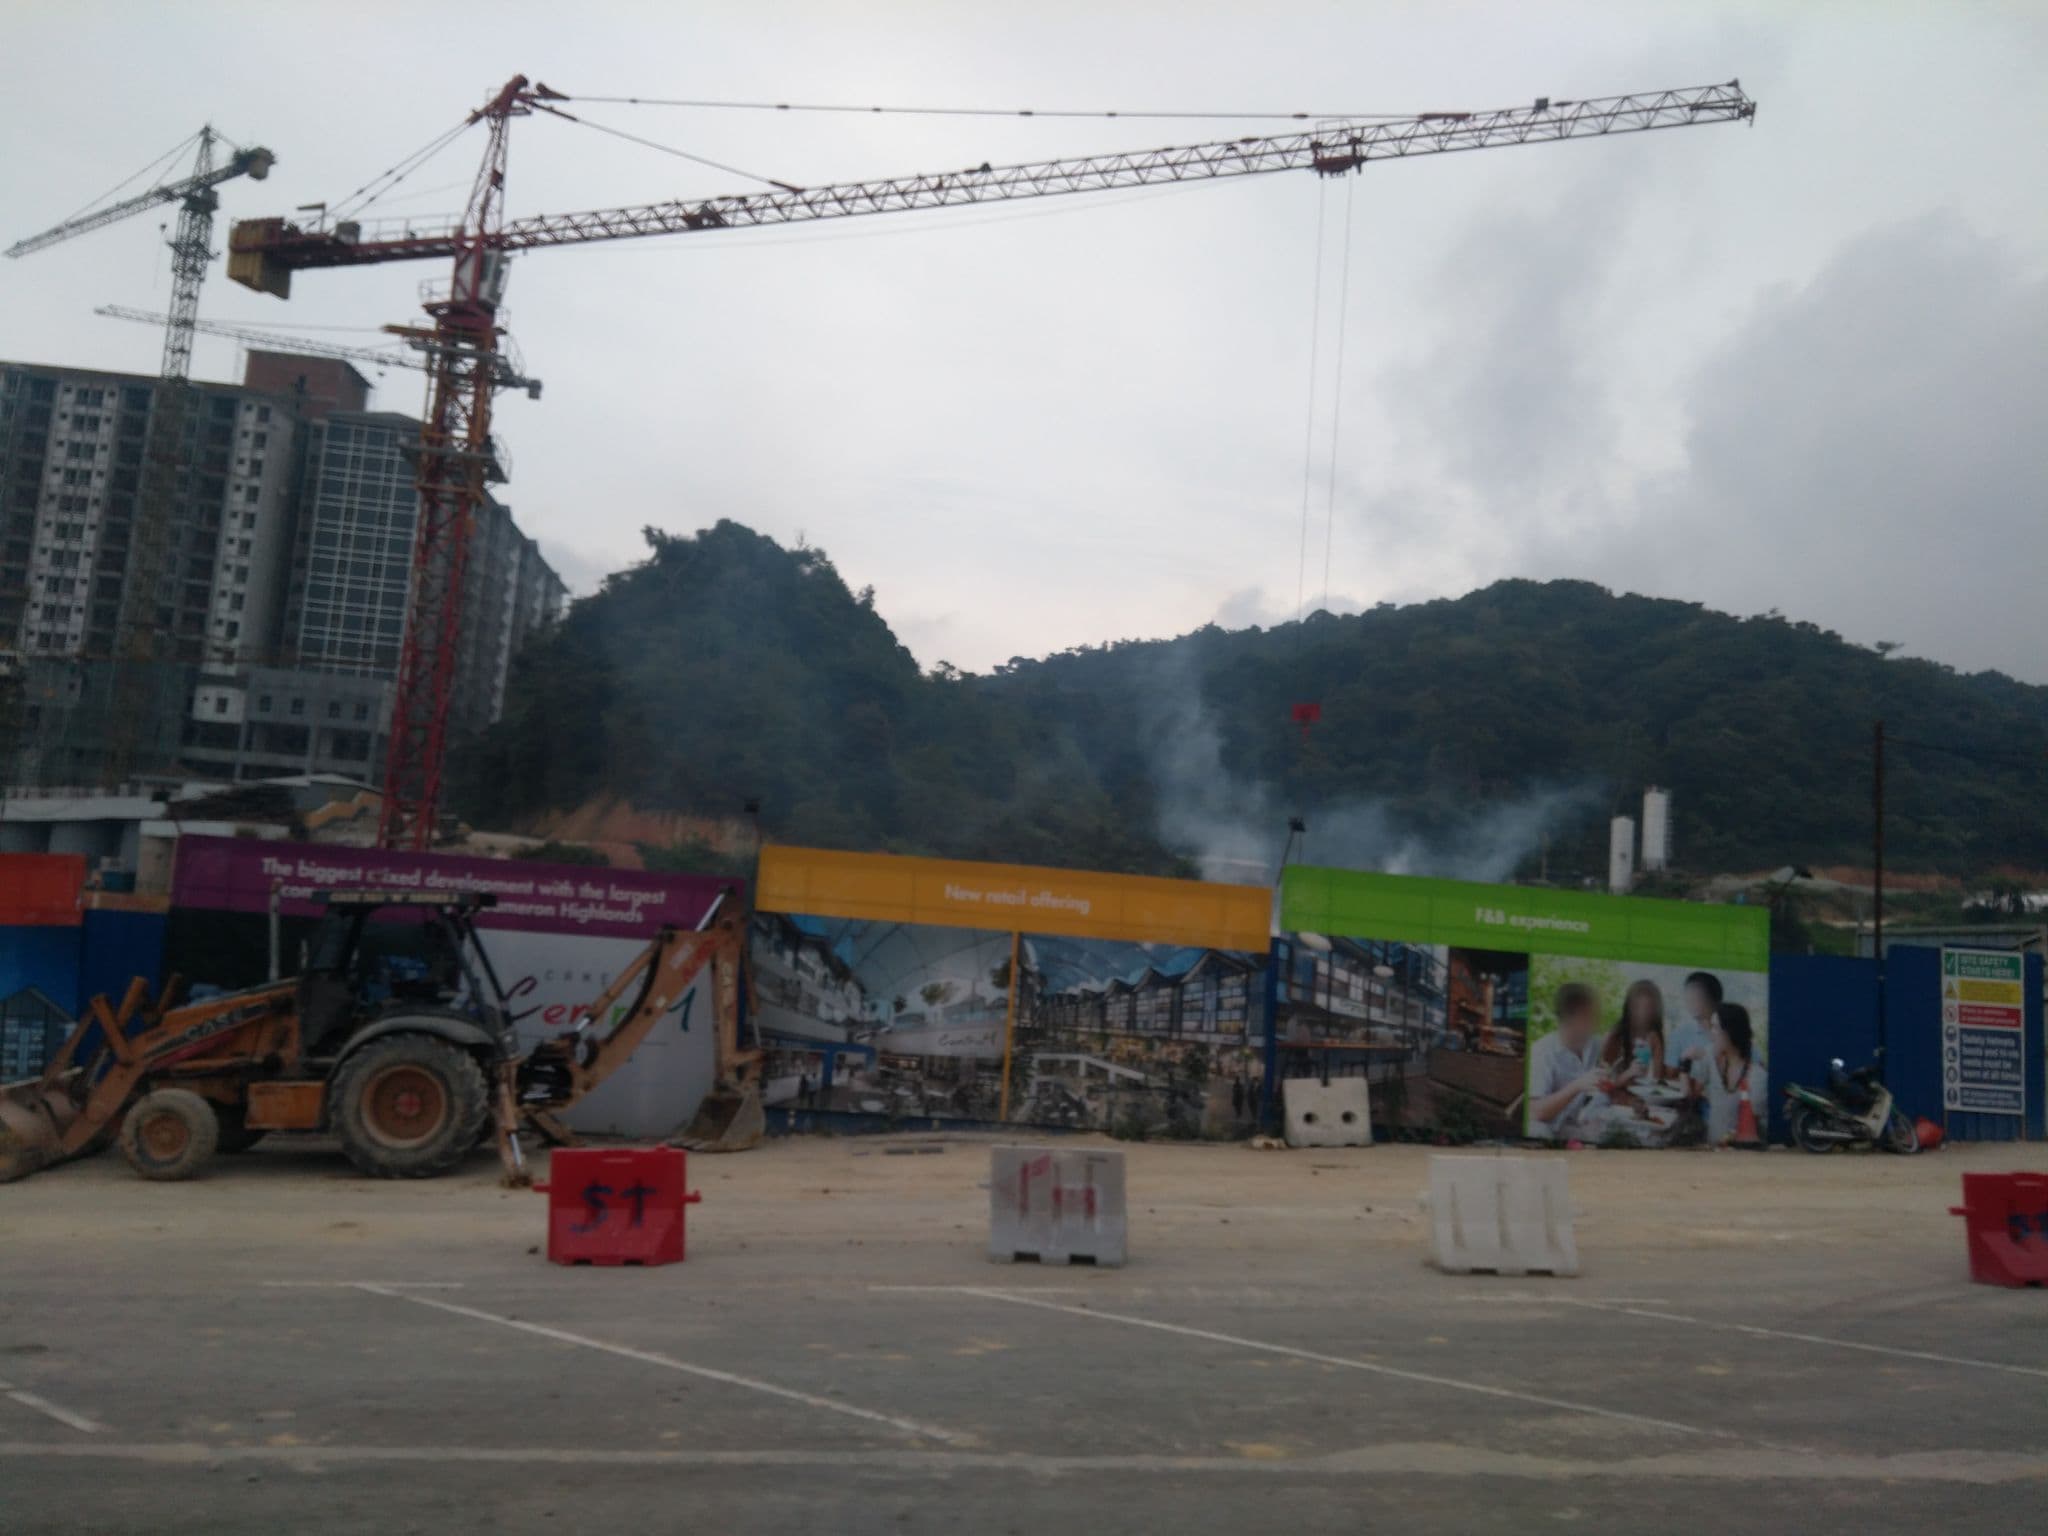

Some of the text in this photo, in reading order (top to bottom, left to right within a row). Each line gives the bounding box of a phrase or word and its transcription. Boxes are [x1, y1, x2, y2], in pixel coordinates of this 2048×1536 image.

[261, 856, 294, 877] The
[296, 859, 362, 885] biggest
[424, 869, 535, 895] development
[537, 879, 575, 898] with
[578, 880, 605, 900] the
[609, 883, 667, 910] largest
[560, 902, 643, 924] Highlands
[944, 882, 1091, 915] New retail offering
[1475, 906, 1590, 934] F&B experience
